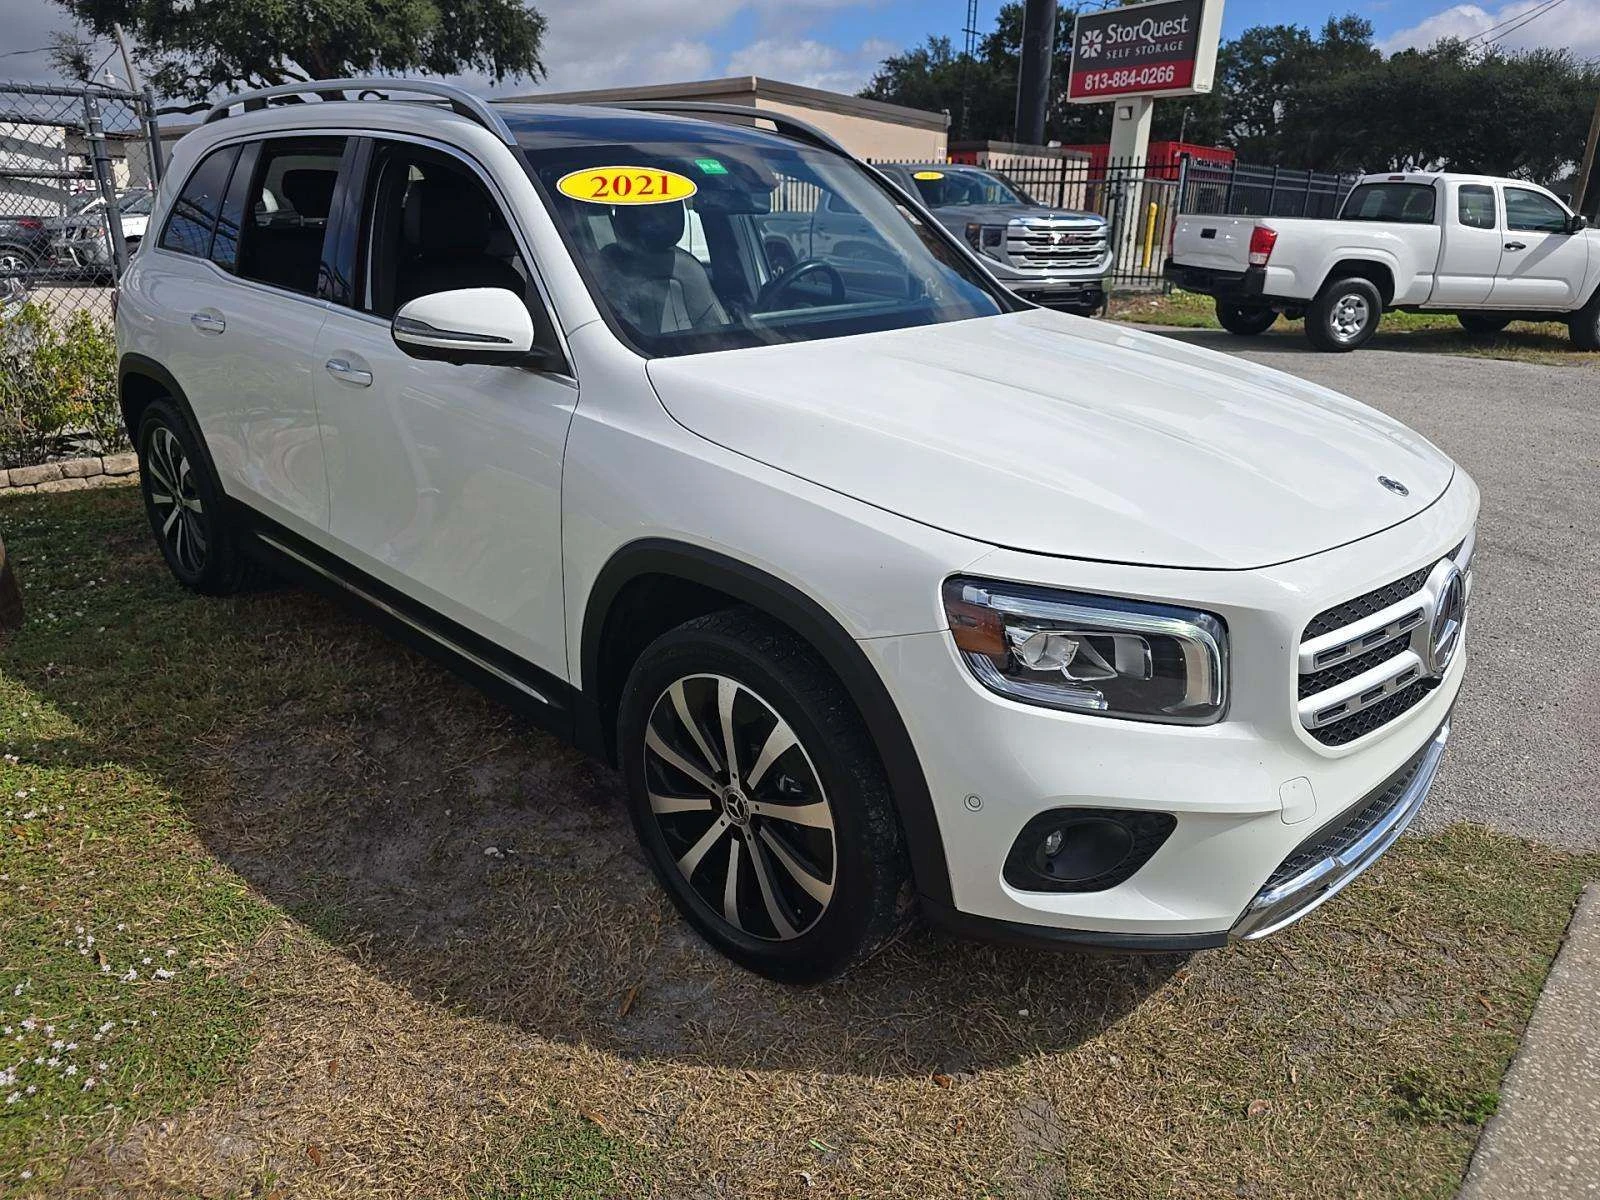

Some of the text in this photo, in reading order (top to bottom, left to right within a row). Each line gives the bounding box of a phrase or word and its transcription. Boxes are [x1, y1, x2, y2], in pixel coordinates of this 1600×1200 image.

[1106, 14, 1188, 43] StorQuest
[1106, 41, 1183, 59] SELF STORAGE
[1085, 65, 1174, 90] 813-884-0266
[591, 175, 670, 198] 2021
